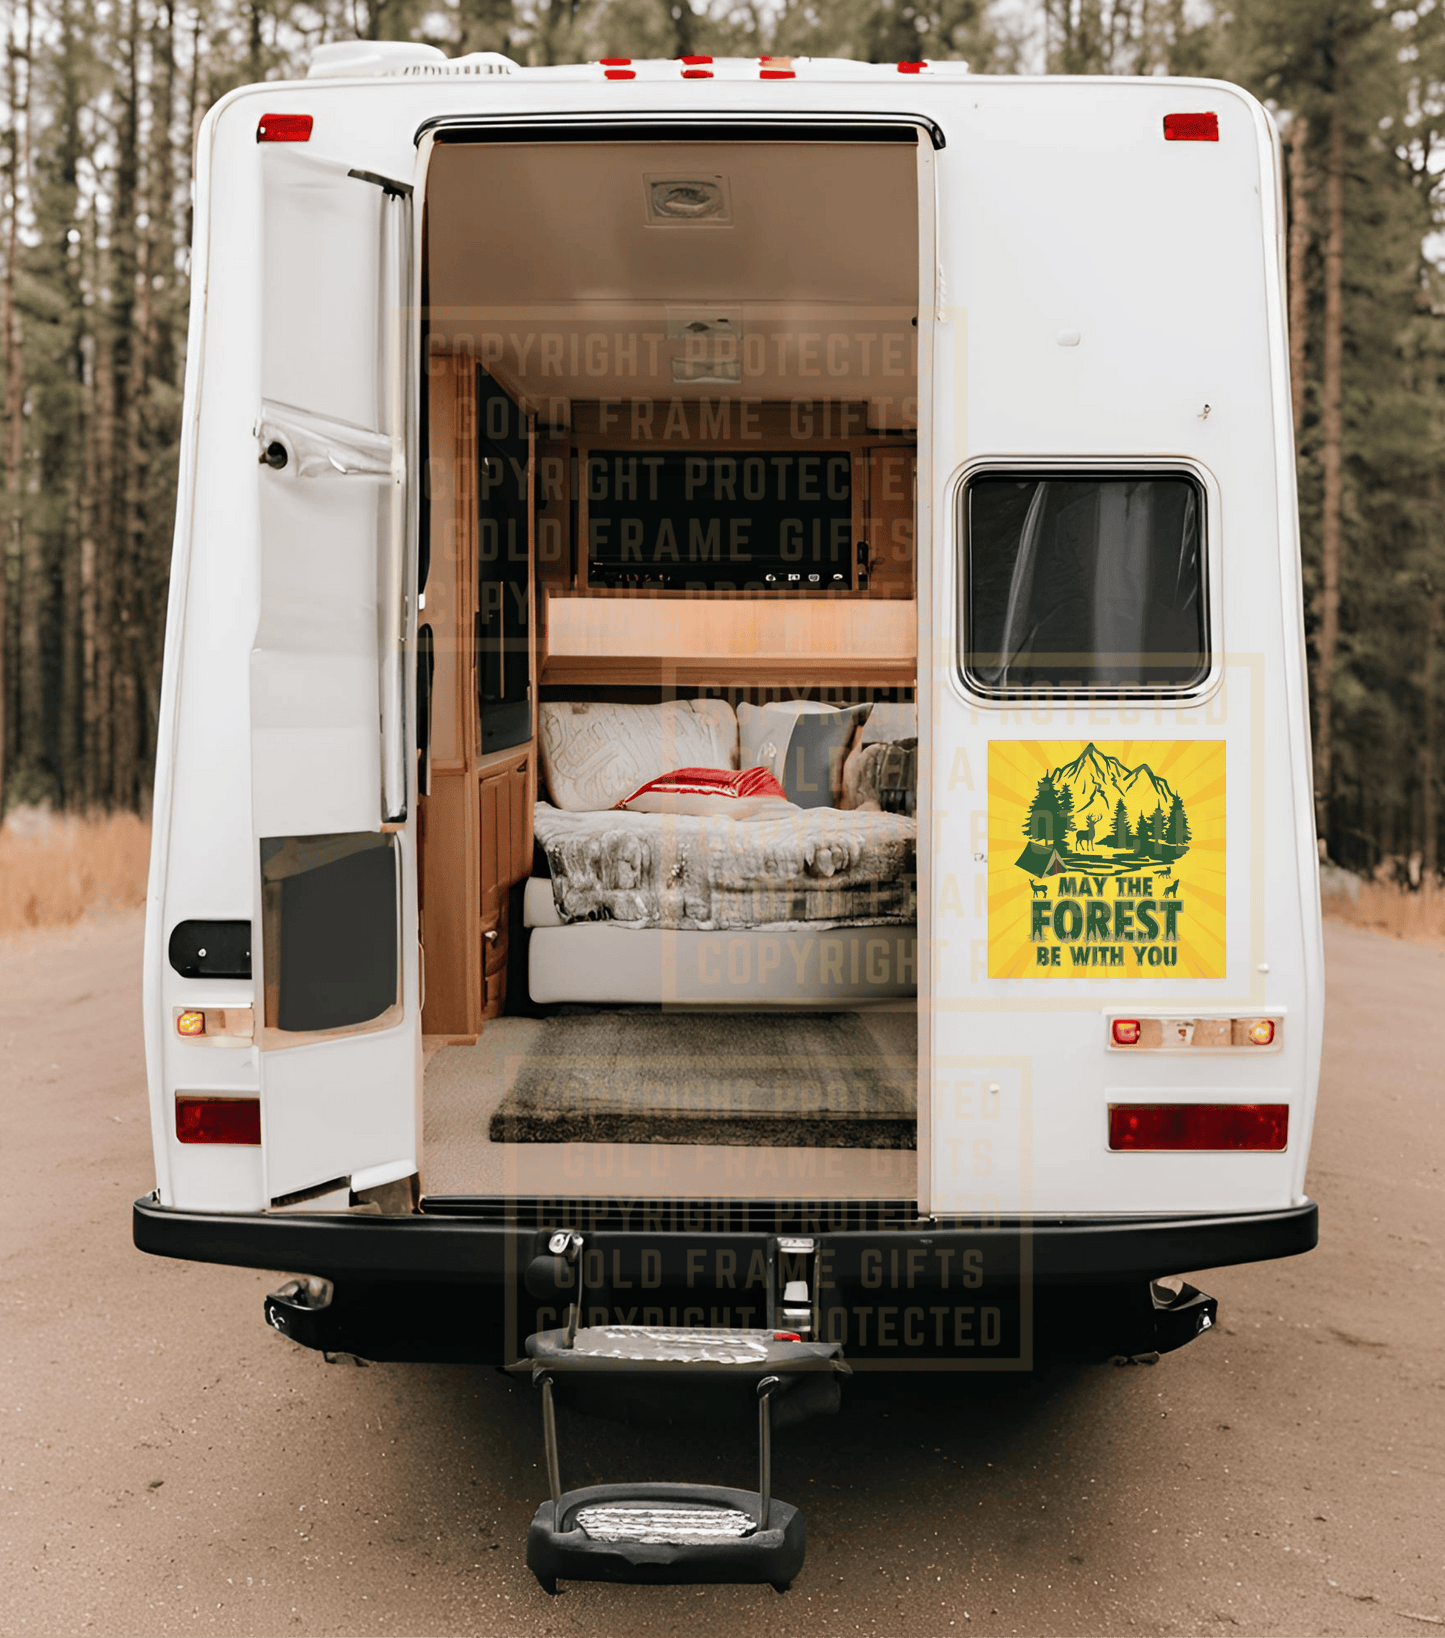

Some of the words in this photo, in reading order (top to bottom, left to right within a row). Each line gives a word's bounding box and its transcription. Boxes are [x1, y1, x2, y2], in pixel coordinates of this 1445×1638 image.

[1058, 877, 1108, 897] MAY
[1115, 877, 1153, 897] THE
[1028, 898, 1184, 943] FOREST
[1036, 946, 1061, 967] BE
[1069, 946, 1125, 967] WITH
[1132, 946, 1178, 967] YOU
